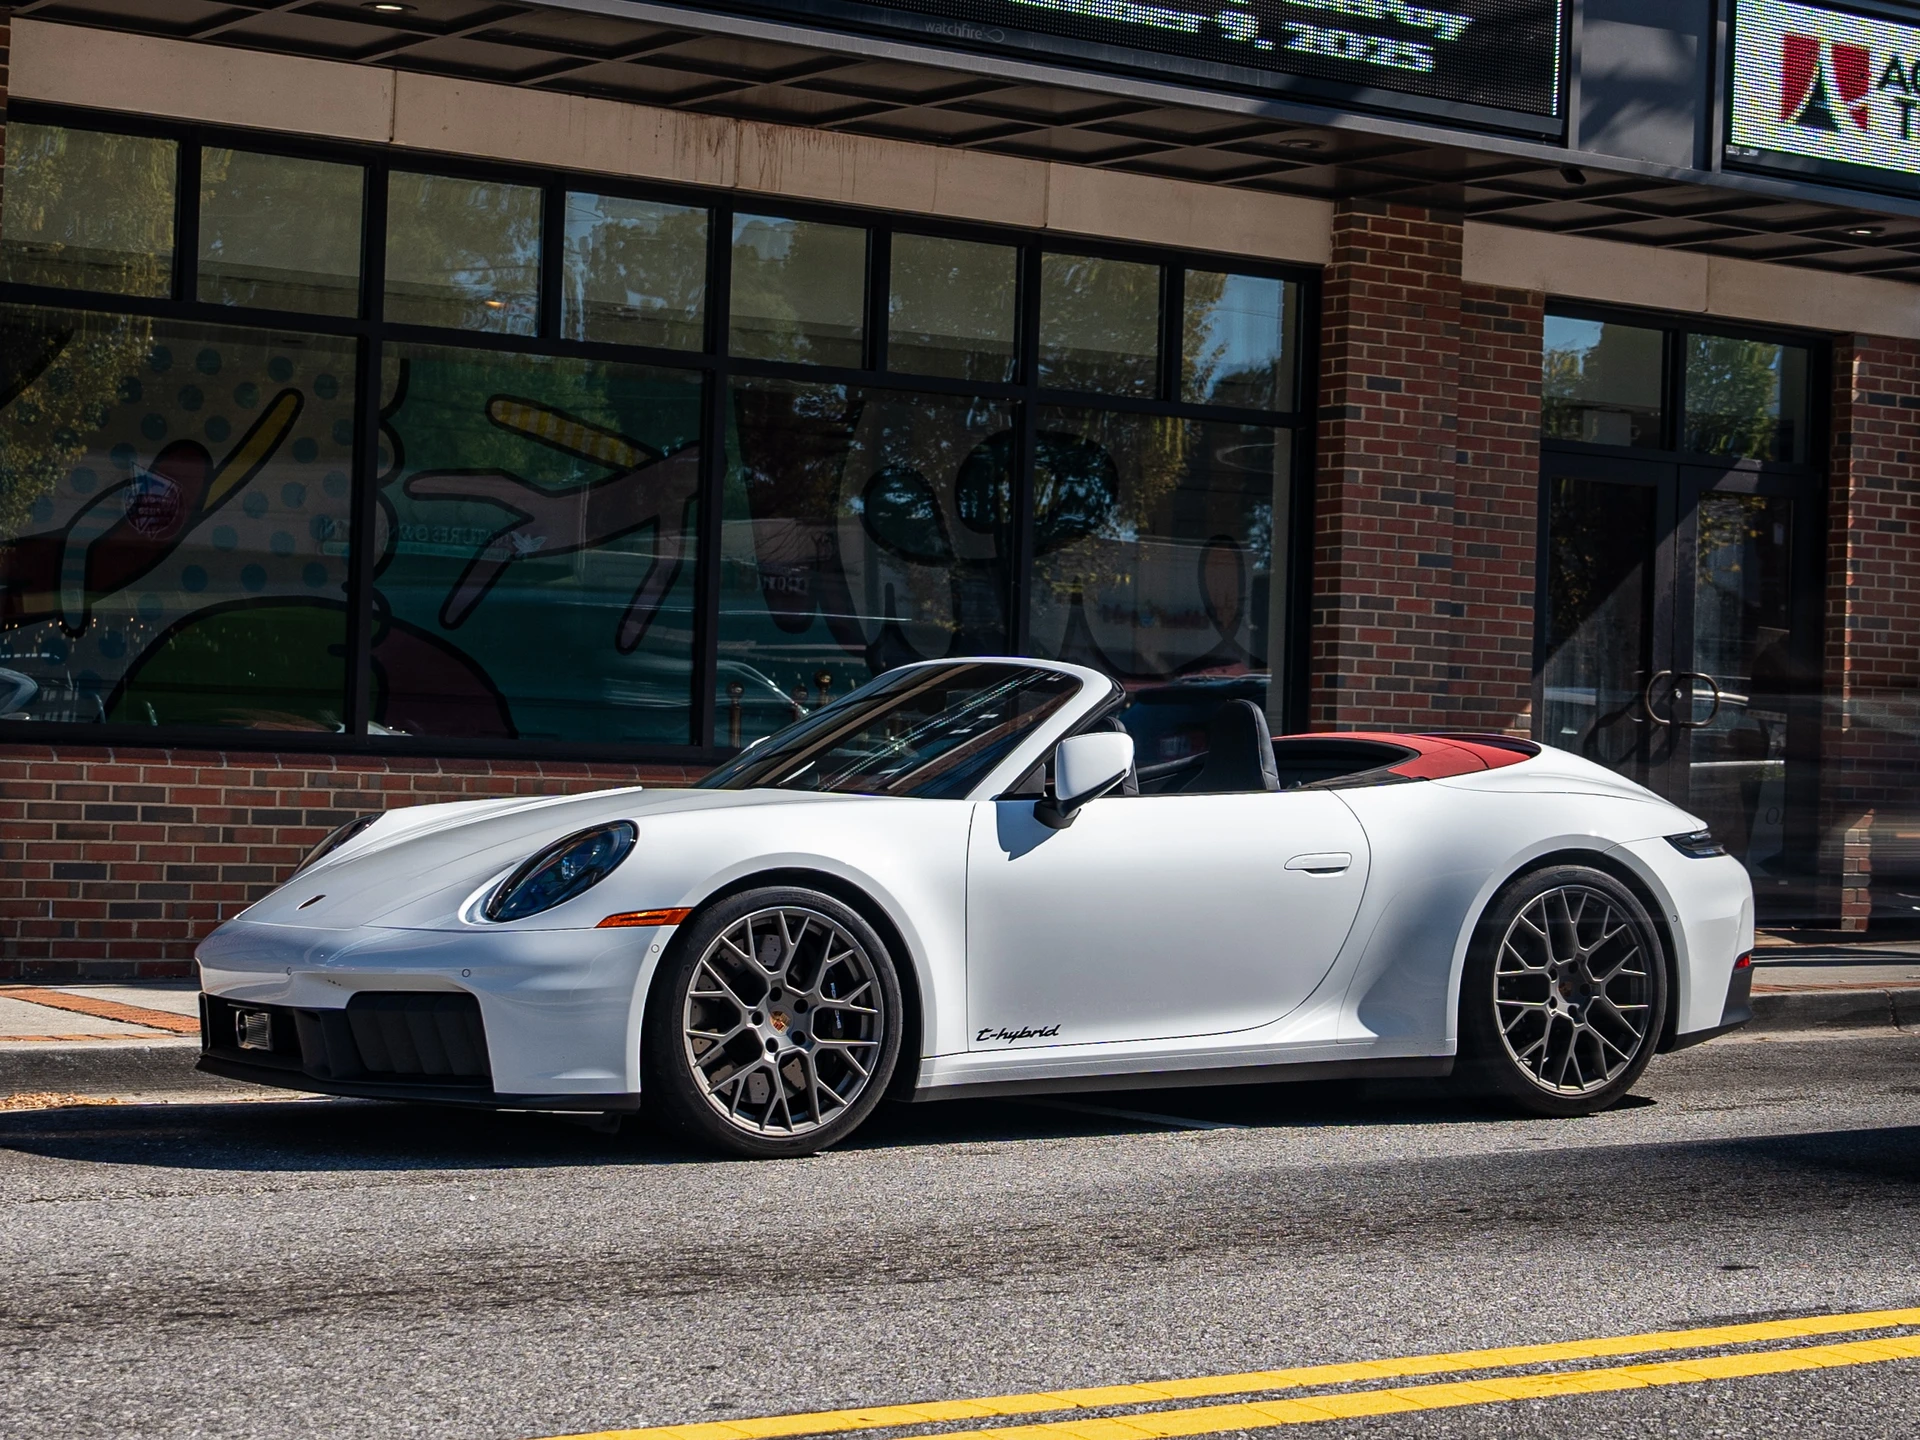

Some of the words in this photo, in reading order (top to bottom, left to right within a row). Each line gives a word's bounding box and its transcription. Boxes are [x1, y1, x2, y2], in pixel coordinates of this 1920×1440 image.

[925, 21, 983, 40] watchfire
[1281, 20, 1436, 73] 2025
[976, 1024, 1061, 1044] t-hybrid
